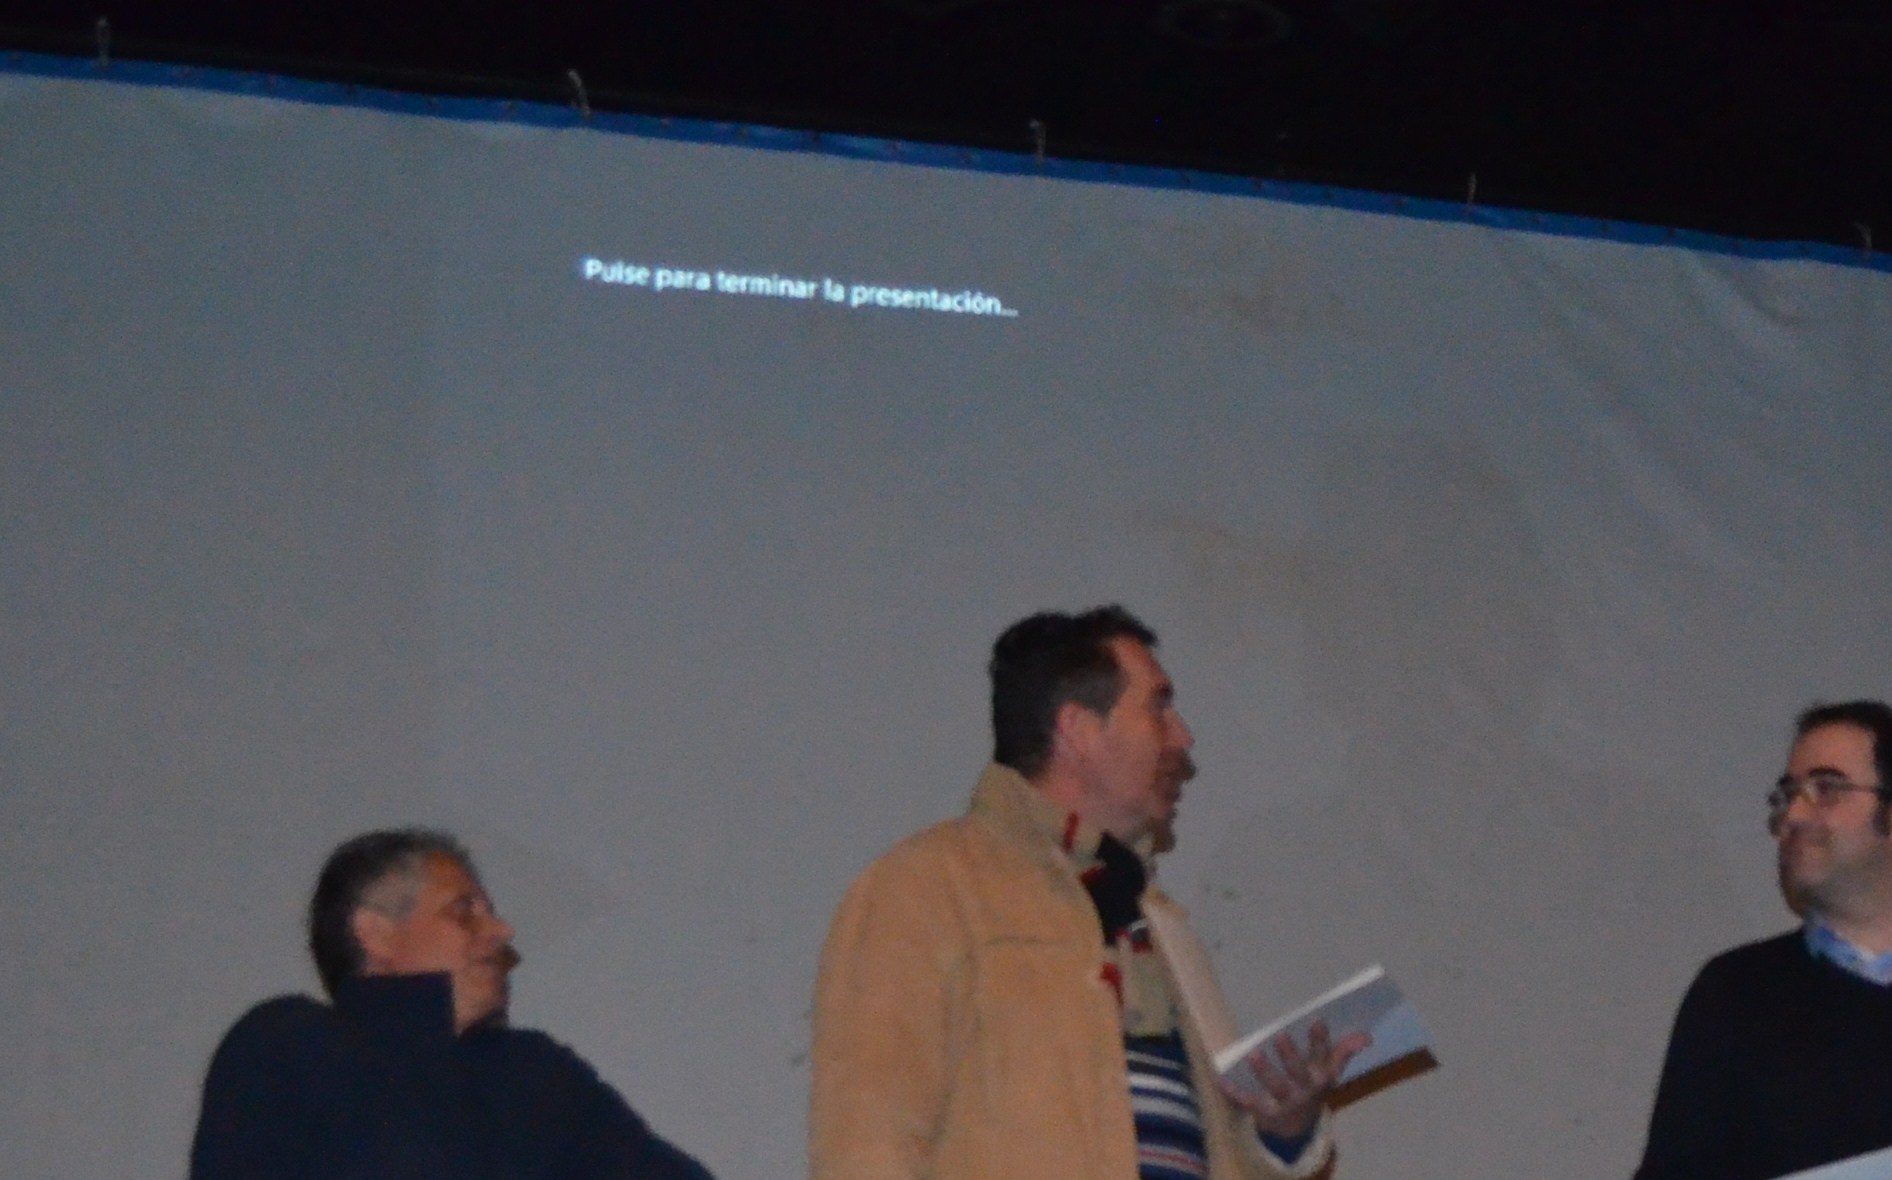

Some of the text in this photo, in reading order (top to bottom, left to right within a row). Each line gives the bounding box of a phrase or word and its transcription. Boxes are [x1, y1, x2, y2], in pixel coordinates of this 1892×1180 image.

[584, 258, 1019, 317] Pulse para terminar la presentación...
